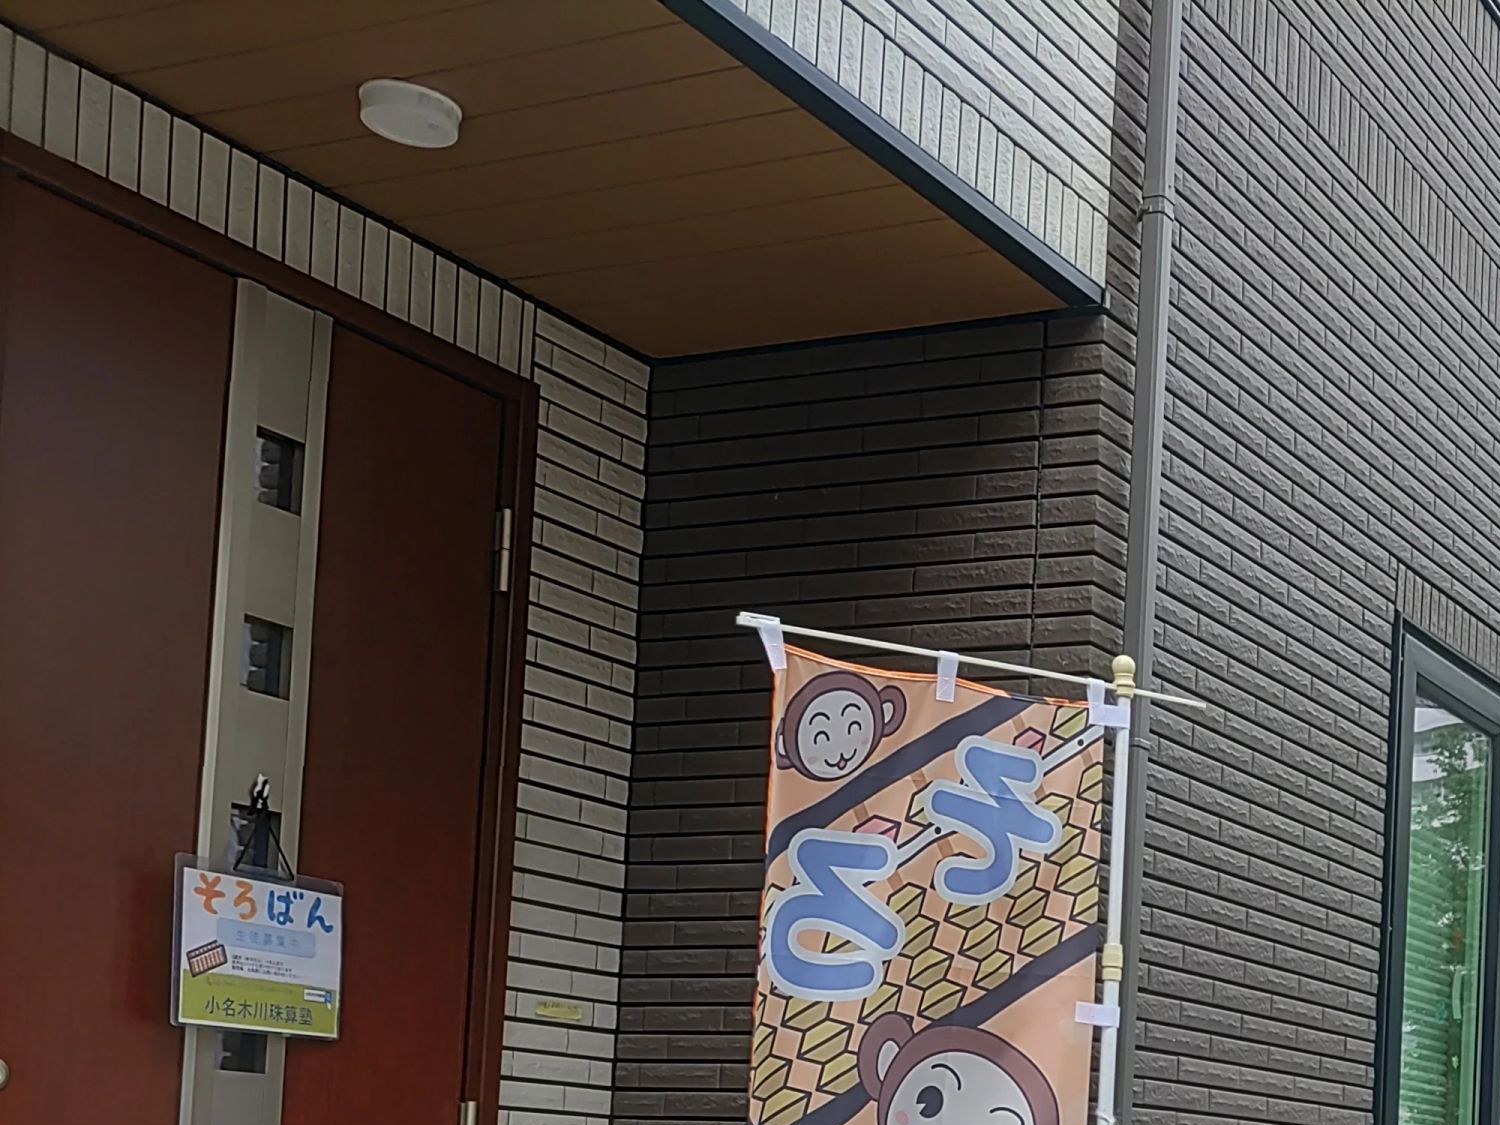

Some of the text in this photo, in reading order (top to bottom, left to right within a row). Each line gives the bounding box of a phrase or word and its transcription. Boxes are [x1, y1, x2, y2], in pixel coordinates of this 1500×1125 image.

[193, 872, 334, 934] そろばん
[205, 994, 313, 1026] 小名木川珠算塾
